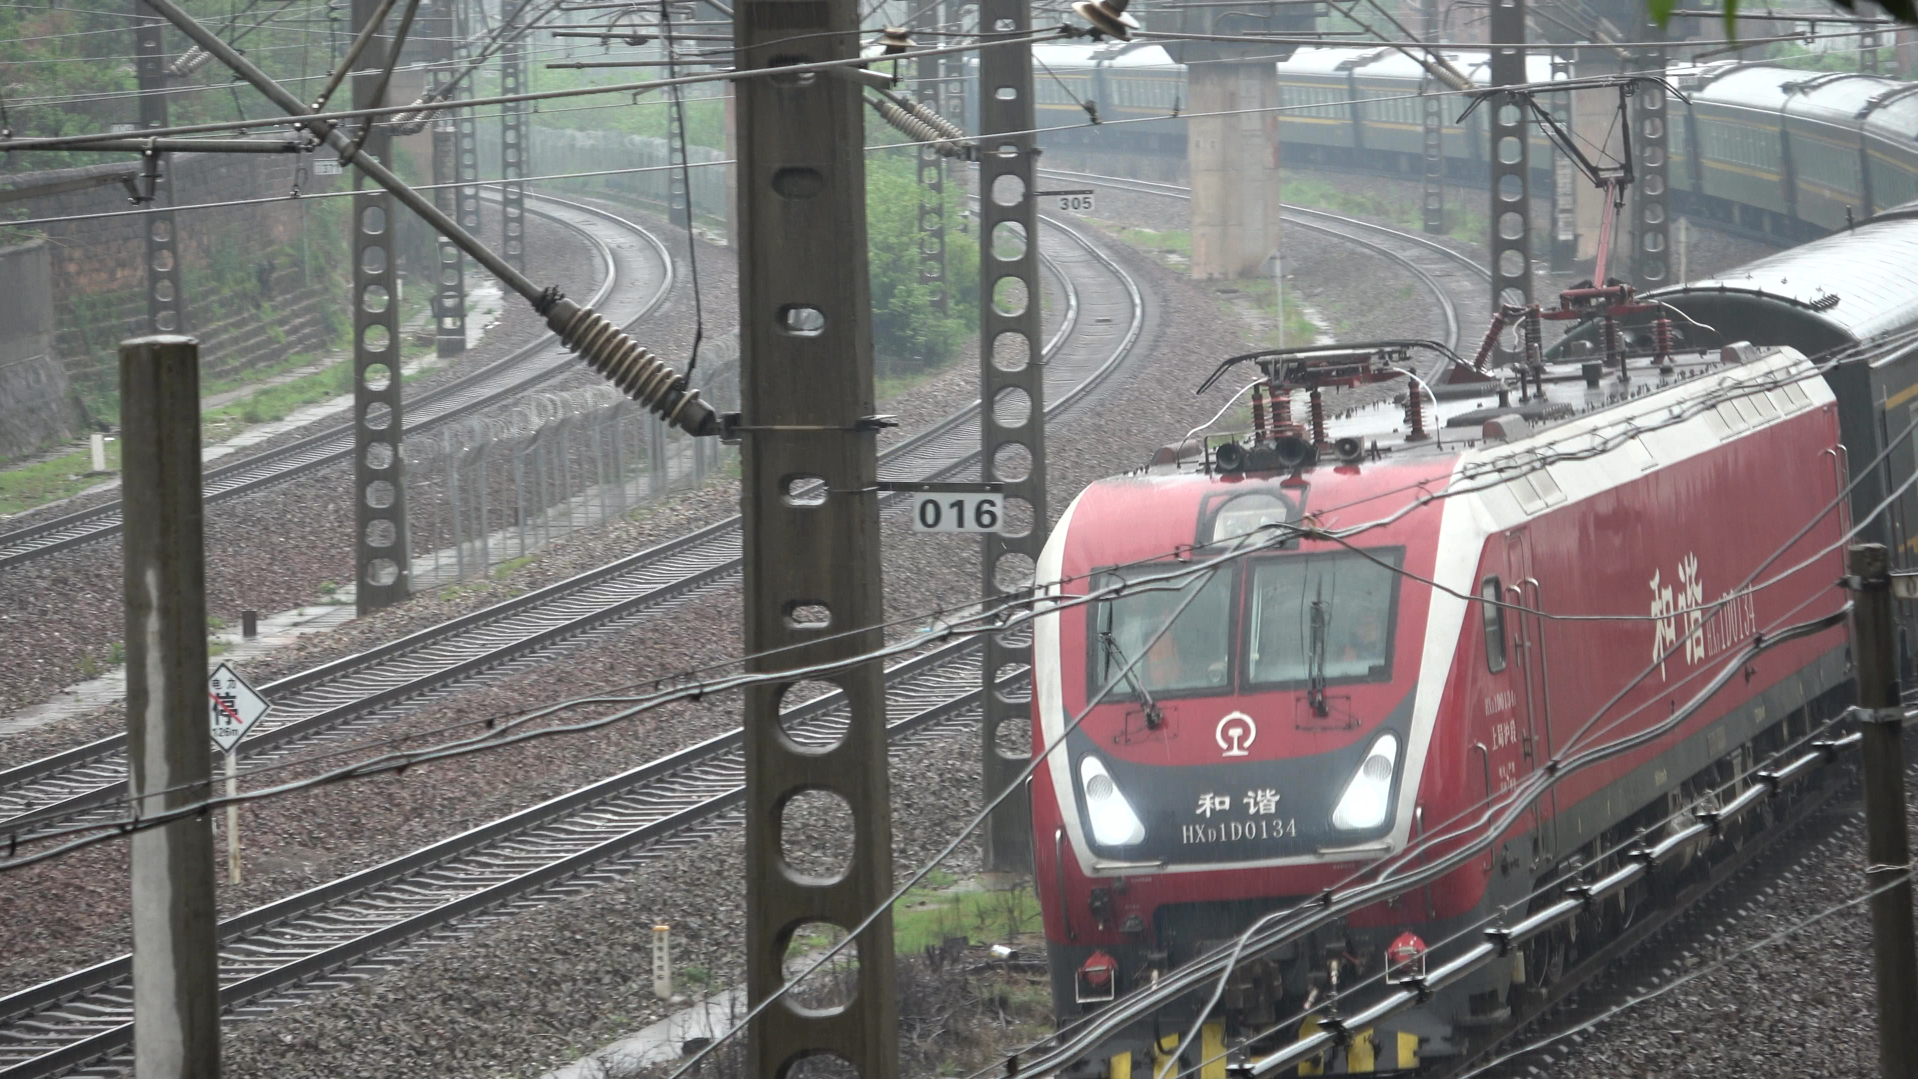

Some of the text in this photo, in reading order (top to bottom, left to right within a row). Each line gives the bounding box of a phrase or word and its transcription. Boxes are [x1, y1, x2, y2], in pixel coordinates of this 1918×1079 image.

[1060, 196, 1092, 210] 305
[919, 498, 999, 530] 016
[1649, 551, 1704, 682] 和谐
[212, 678, 237, 690] 电力
[212, 691, 238, 725] 停
[1195, 788, 1281, 819] 和谐
[1182, 818, 1298, 844] HXD1D0134
